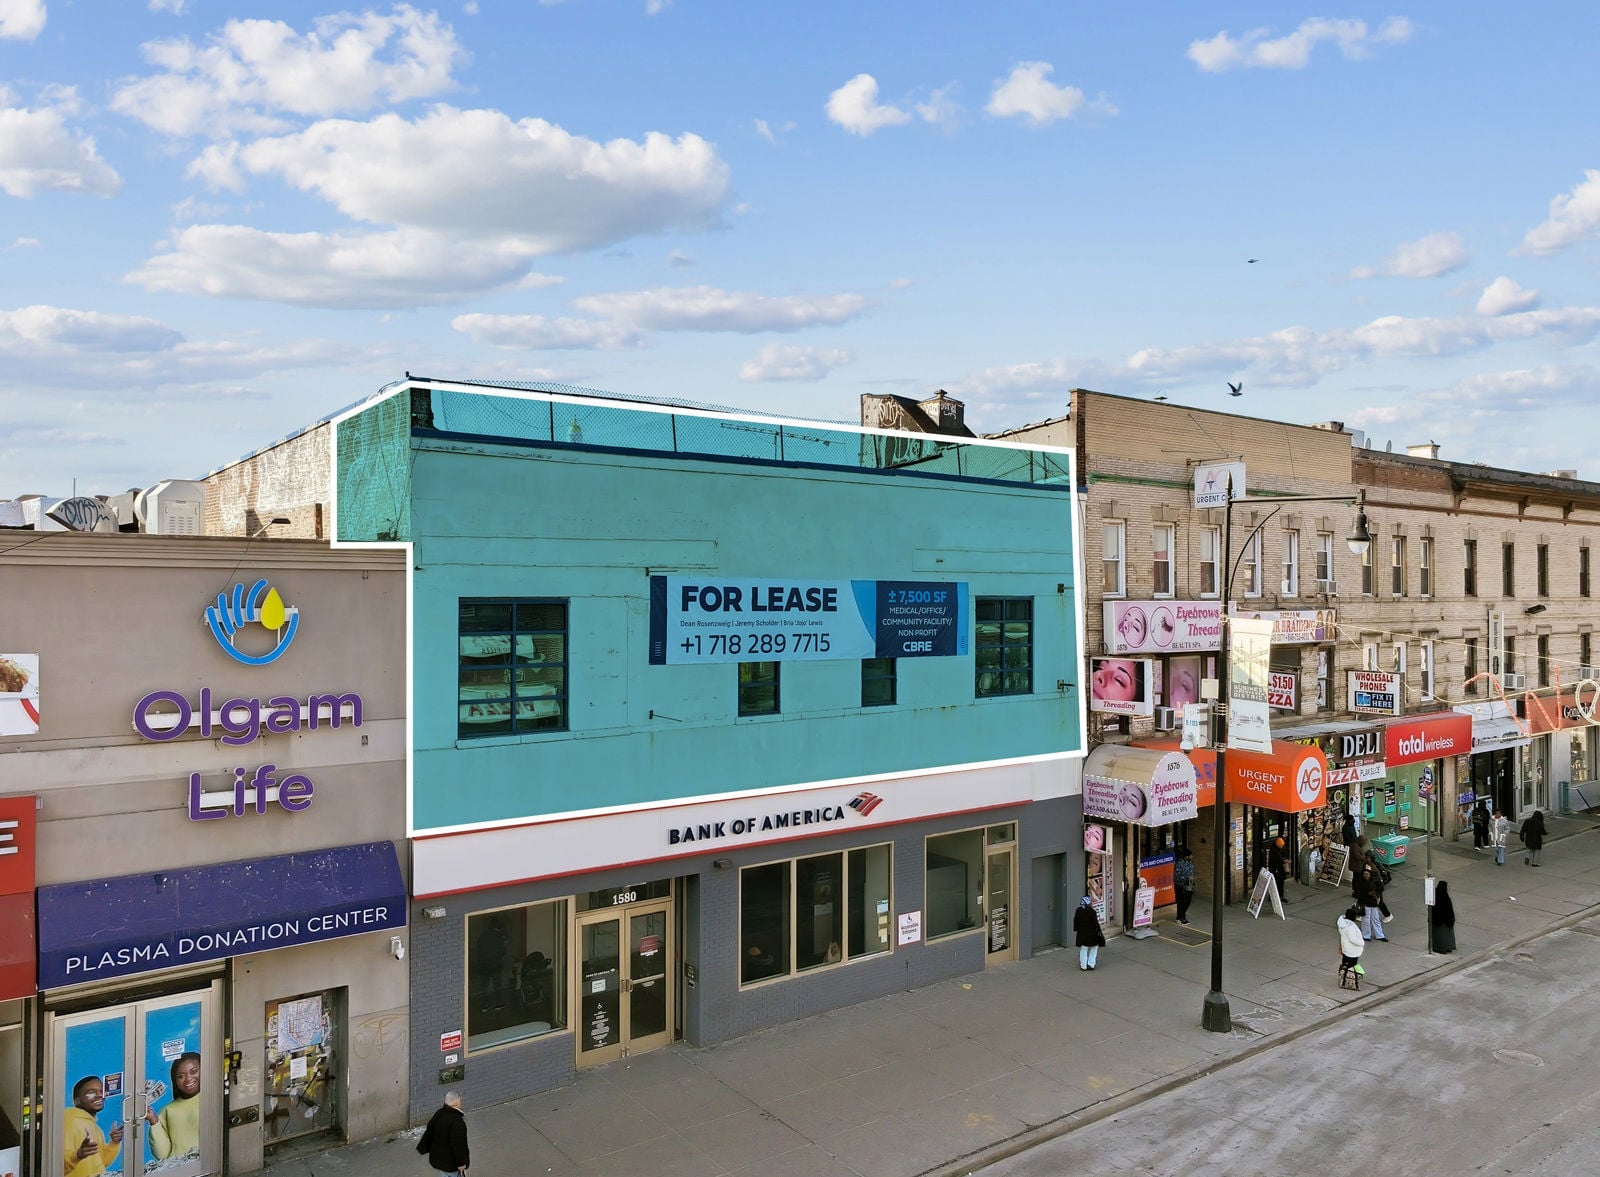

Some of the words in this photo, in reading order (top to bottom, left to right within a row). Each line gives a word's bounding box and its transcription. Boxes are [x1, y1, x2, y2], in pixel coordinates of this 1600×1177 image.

[1197, 494, 1219, 503] URGENT
[681, 586, 742, 612] FOR
[751, 587, 838, 612] LEASE
[899, 590, 931, 604] 7,500
[934, 591, 947, 603] SF
[1176, 606, 1219, 623] Eyebrows
[696, 620, 731, 628] Rosenzweig
[734, 620, 754, 628] Jeremy
[783, 619, 794, 627] Bria
[808, 619, 823, 627] Lewis
[882, 618, 922, 626] COMMUNITY
[898, 629, 914, 637] NON
[914, 629, 938, 637] PROFIT
[680, 635, 701, 655] +1
[709, 634, 742, 655] 718
[748, 634, 786, 654] 289
[792, 633, 831, 653] 7715
[902, 641, 933, 652] CBRE
[1273, 674, 1293, 690] $1.50
[1354, 672, 1394, 683] WHOLESALE
[1359, 681, 1387, 692] PHONES
[1371, 693, 1384, 701] FIX
[1371, 700, 1393, 708] HERE
[1103, 700, 1136, 710] Threading
[133, 687, 364, 745] Olgam
[1342, 731, 1381, 758] DELI
[1399, 731, 1425, 756] total
[1425, 736, 1454, 752] wireless
[1166, 761, 1181, 772] 1576
[1238, 768, 1285, 784] URGENT
[1086, 779, 1114, 791] Eyebrows
[1155, 779, 1189, 796] Eyebrows
[1246, 780, 1273, 794] CARE
[189, 764, 315, 821] Life
[1088, 788, 1118, 800] Threading
[1157, 791, 1194, 808] Threading
[1161, 807, 1179, 817] BEAUTY
[668, 821, 725, 845] BANK
[731, 817, 756, 835] OF
[761, 806, 845, 832] AMERICA
[612, 891, 637, 905] 1580
[902, 928, 917, 936] Entrance
[66, 942, 170, 974] PLASMA
[178, 920, 300, 955] DONATION
[307, 906, 388, 933] CENTER
